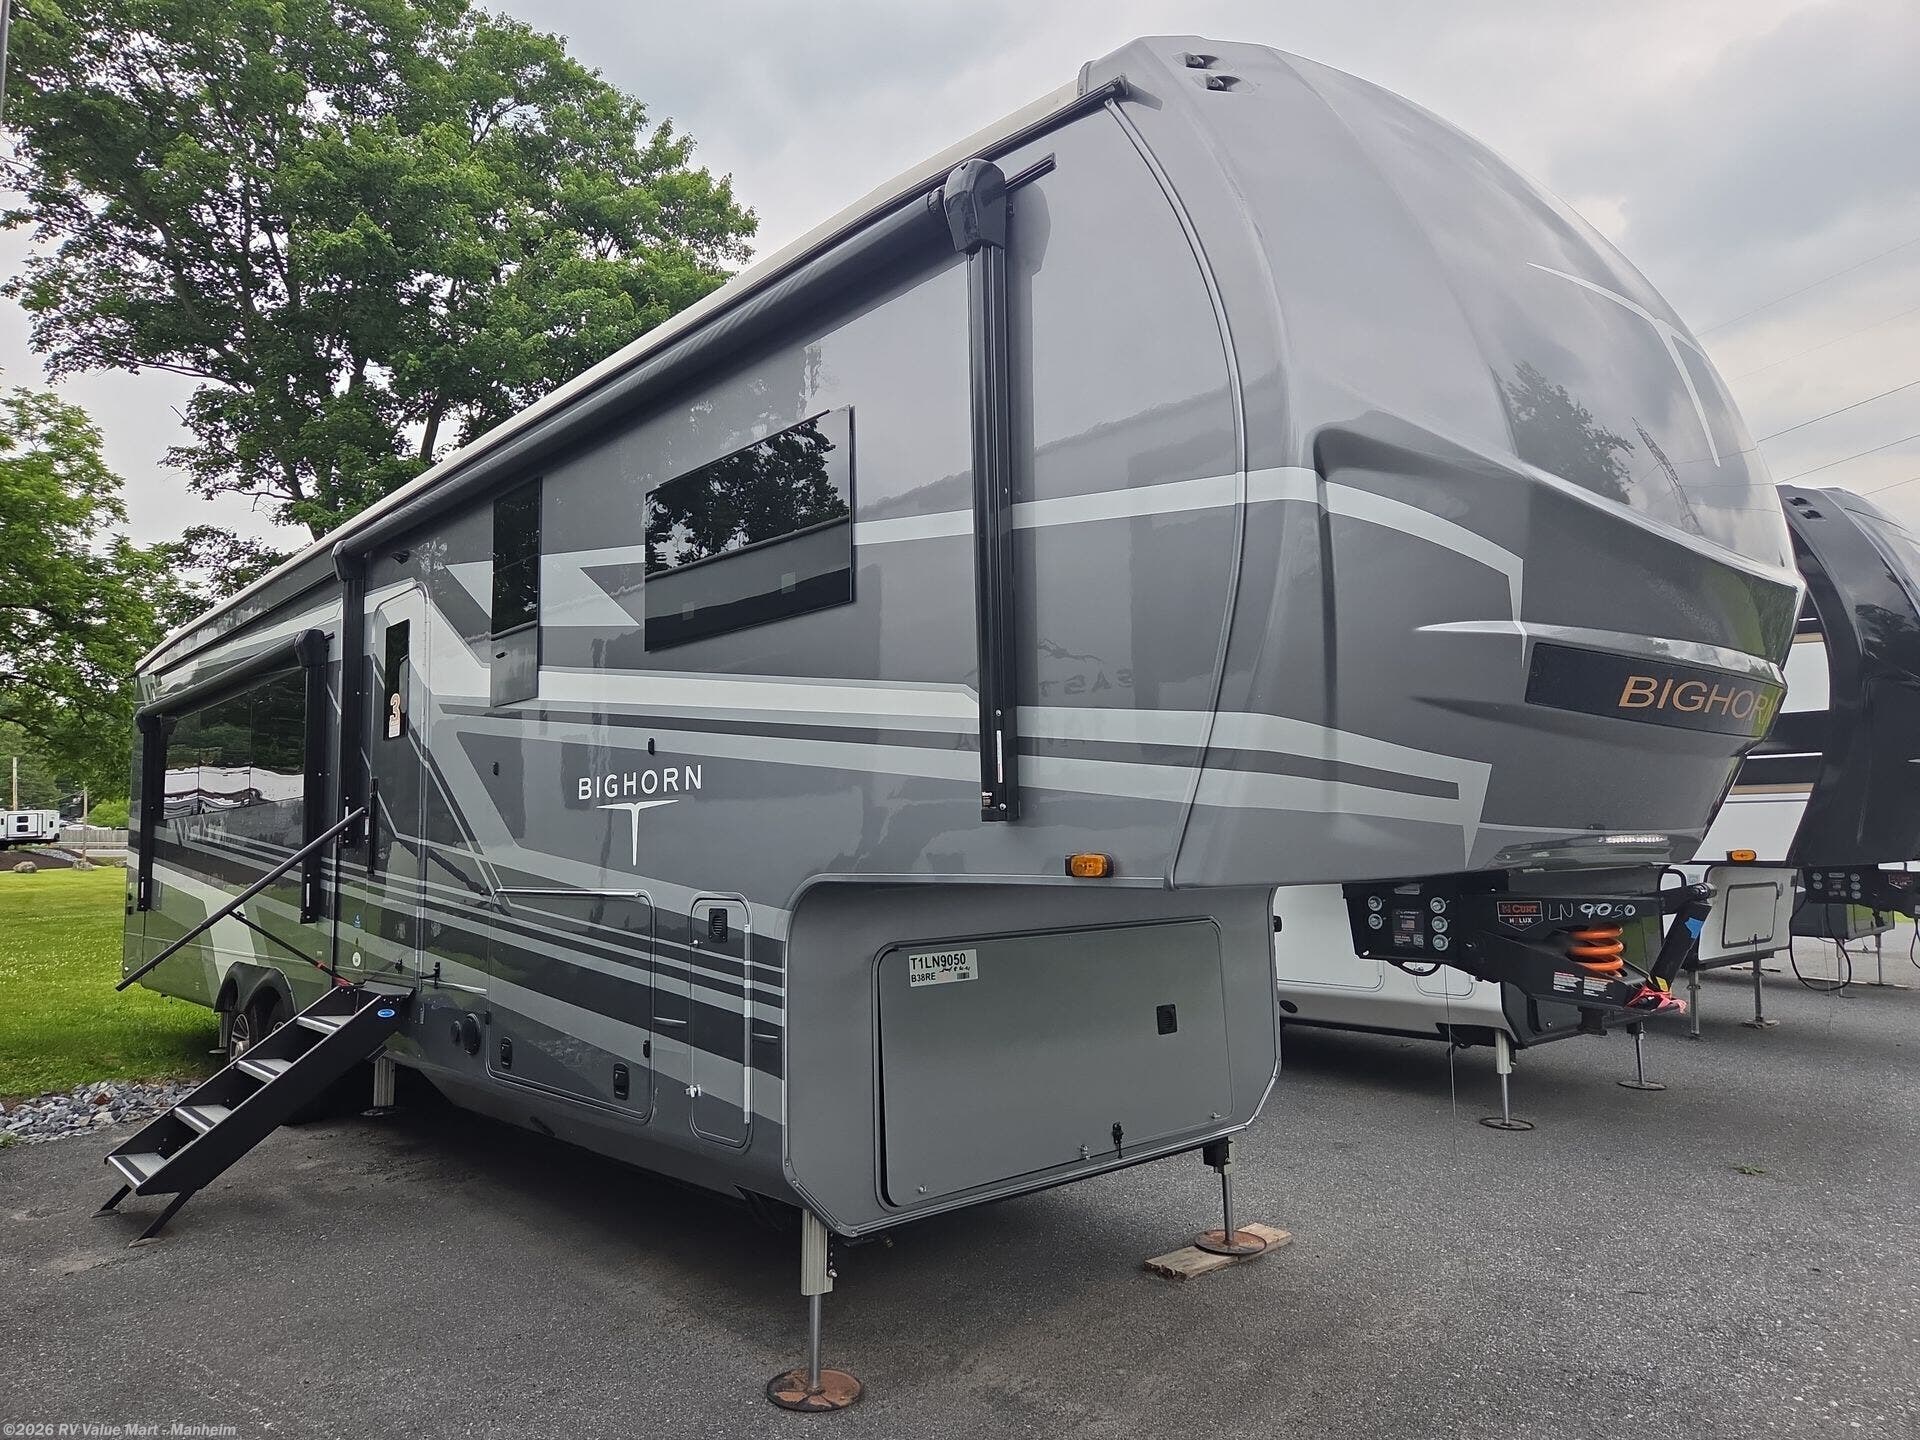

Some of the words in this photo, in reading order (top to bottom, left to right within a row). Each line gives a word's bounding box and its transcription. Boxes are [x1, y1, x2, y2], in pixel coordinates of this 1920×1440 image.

[578, 764, 702, 800] BIGHORN
[1548, 902, 1574, 921] LN
[910, 952, 966, 970] T1LN9050
[911, 972, 936, 983] B38RE
